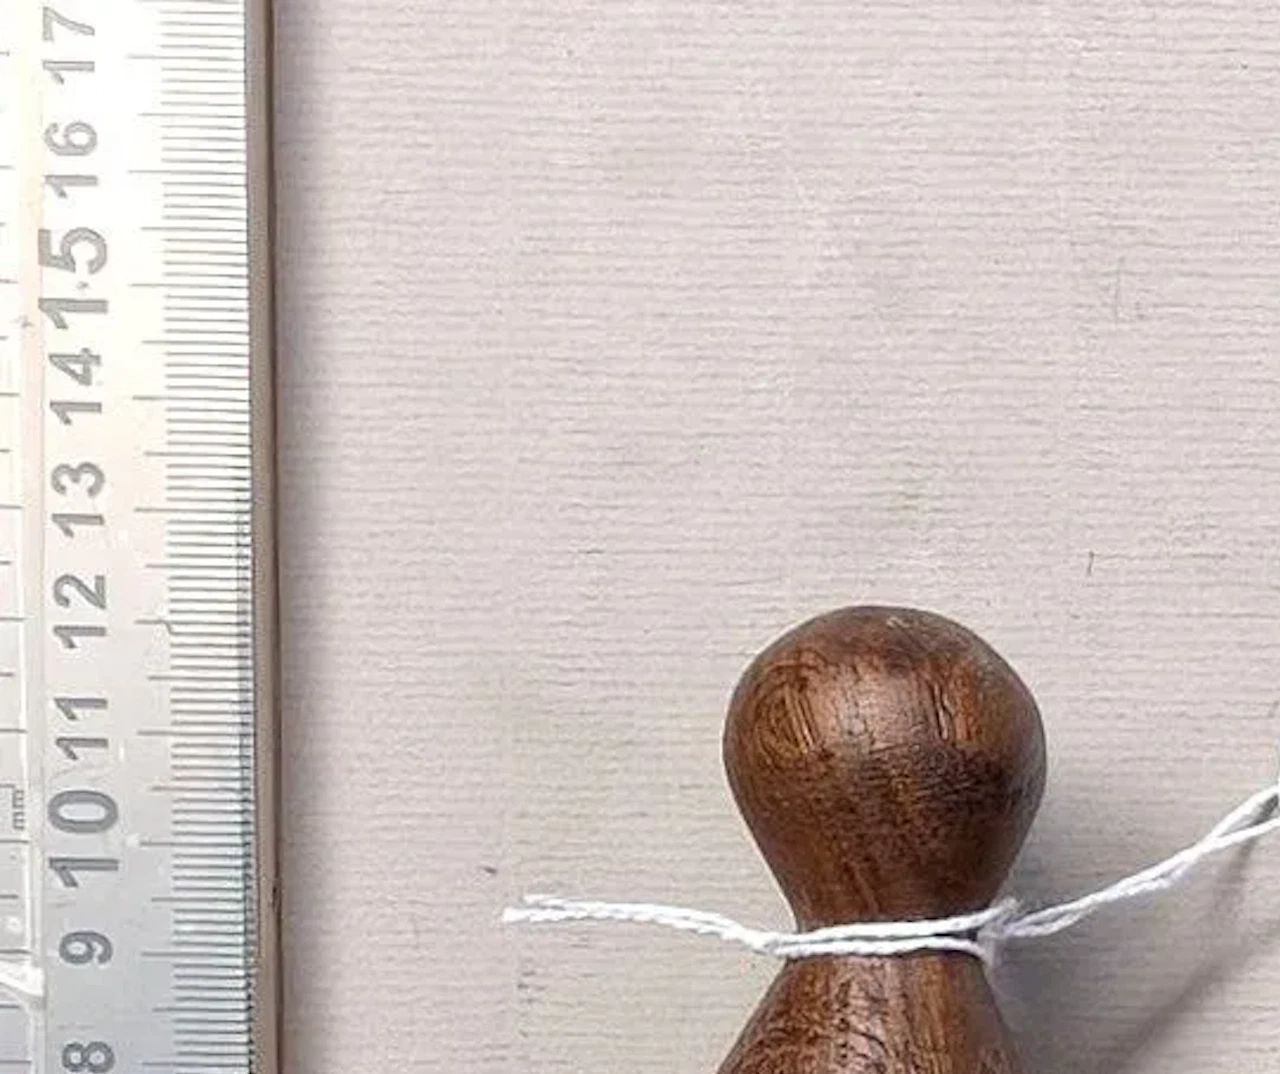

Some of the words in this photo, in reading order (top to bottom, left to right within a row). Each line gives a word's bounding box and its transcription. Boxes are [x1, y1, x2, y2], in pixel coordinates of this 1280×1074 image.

[42, 6, 96, 84] 17
[44, 121, 98, 199] 16
[38, 226, 108, 330] 15
[49, 348, 103, 425] 14
[51, 461, 105, 538] 13
[53, 573, 107, 649] 12
[54, 696, 109, 760] 11
[48, 790, 119, 888] 10
[58, 930, 113, 966] 9
[61, 1041, 116, 1074] 8
